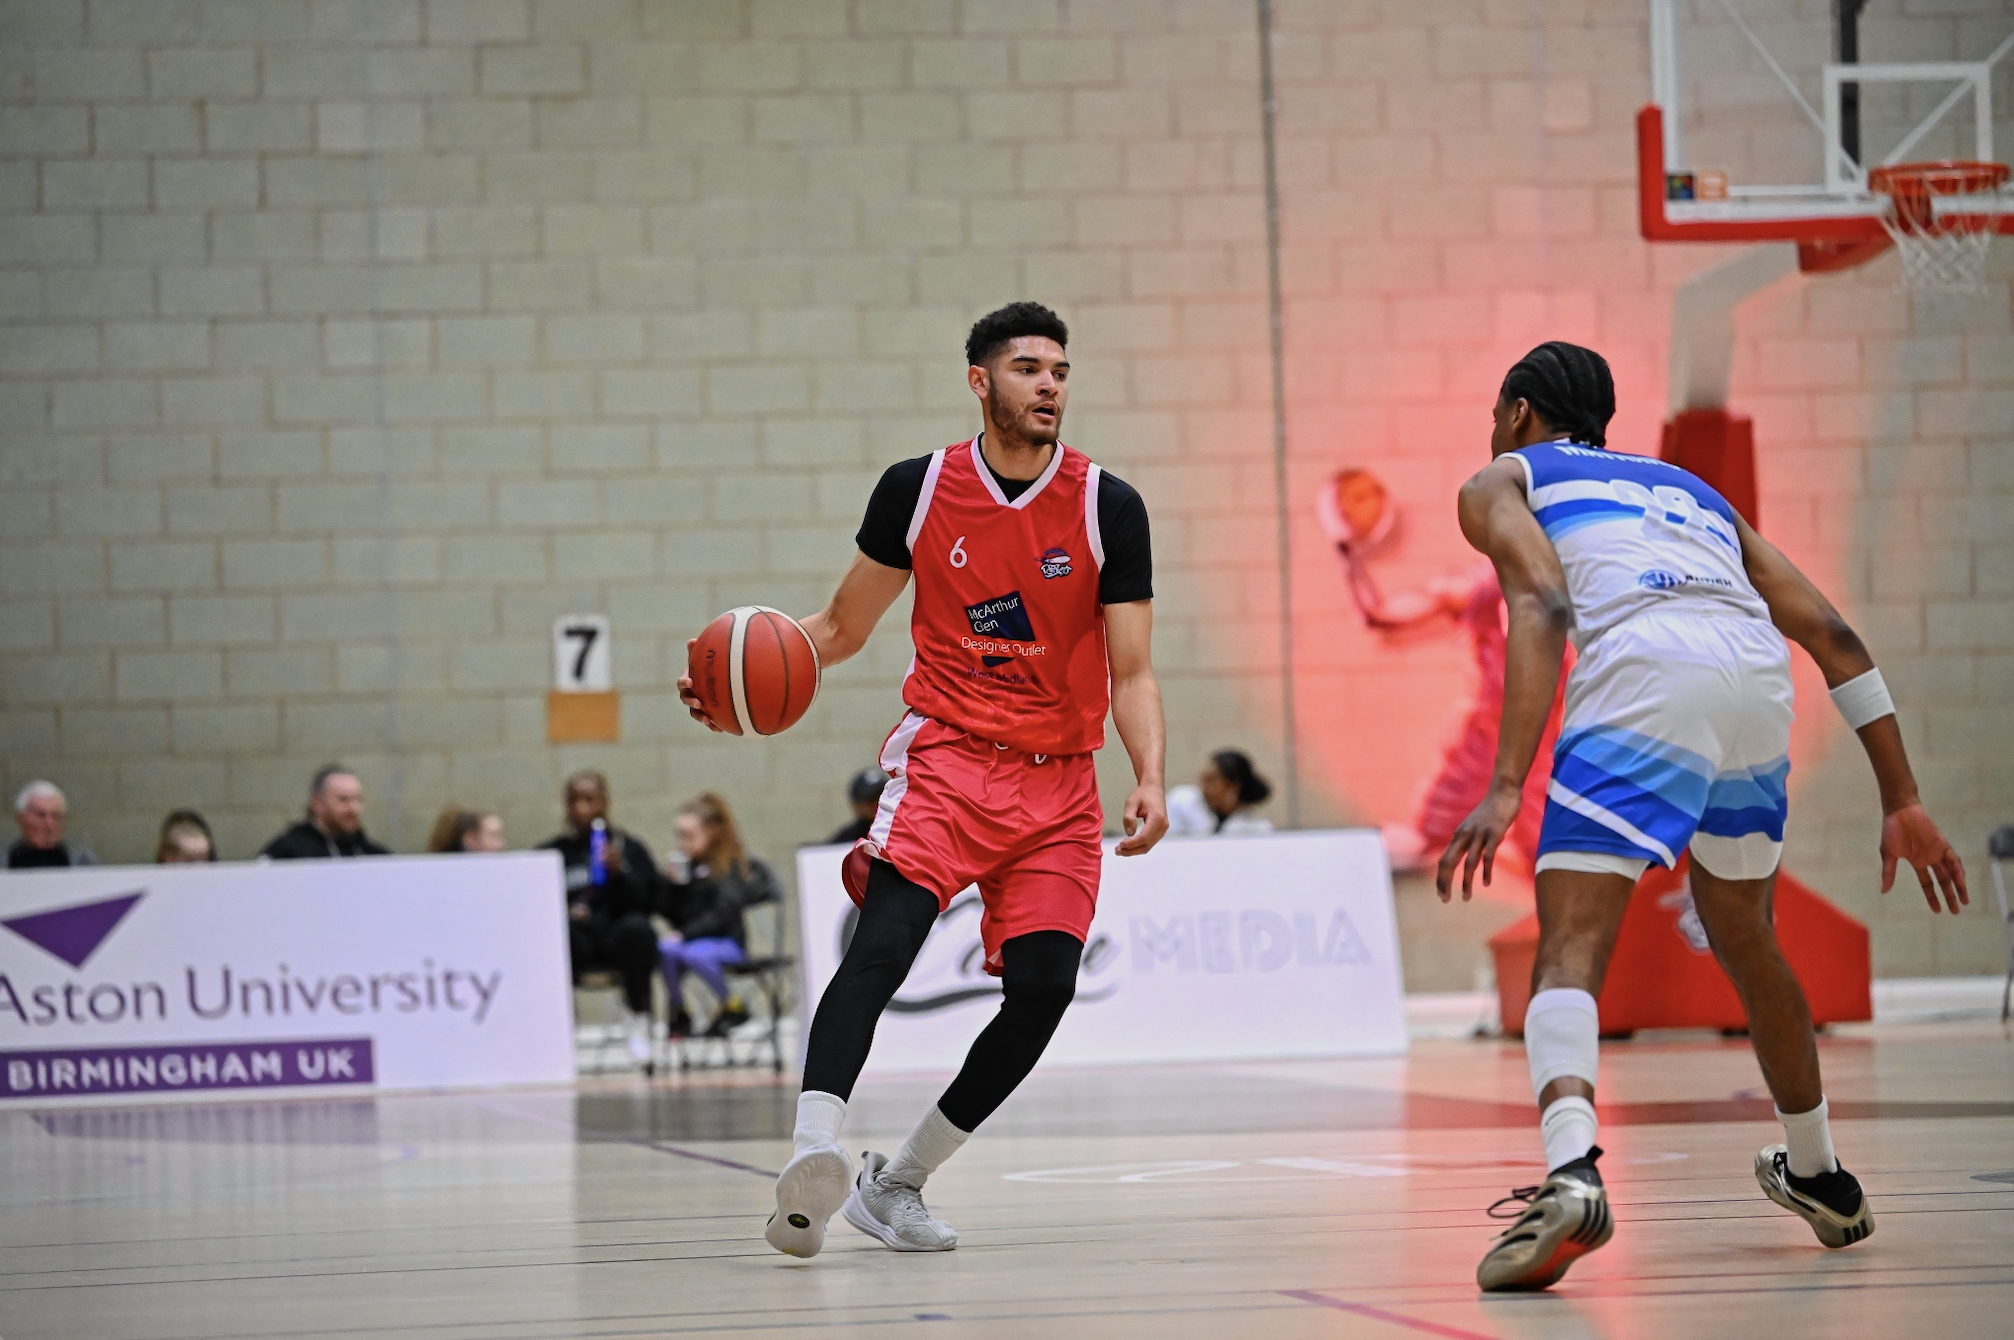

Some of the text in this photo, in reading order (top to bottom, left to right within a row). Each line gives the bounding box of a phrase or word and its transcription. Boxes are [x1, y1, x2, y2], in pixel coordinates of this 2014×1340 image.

[949, 535, 967, 568] 6
[968, 597, 1018, 620] McArthur
[973, 619, 999, 633] Gen
[564, 624, 598, 681] 7
[961, 636, 1046, 656] Designer Outlet
[1128, 905, 1374, 975] MEDIA
[0, 957, 501, 1026] Aston University
[8, 1048, 356, 1091] BIRMINGHAM UK
